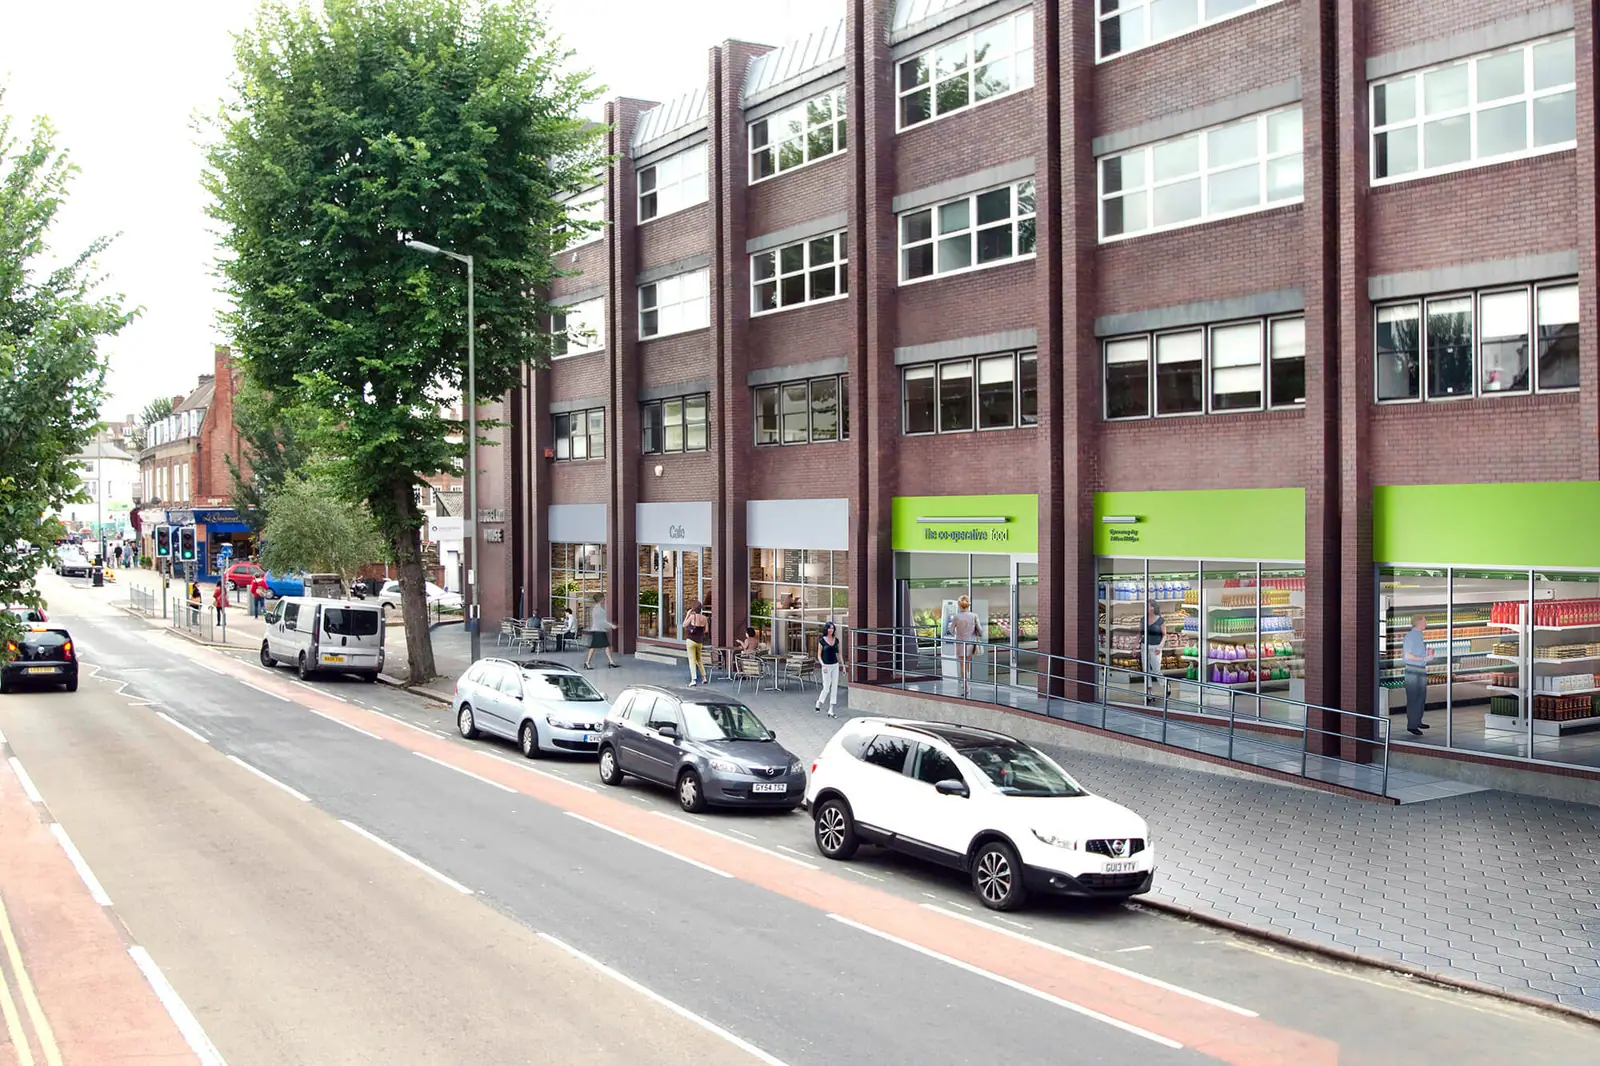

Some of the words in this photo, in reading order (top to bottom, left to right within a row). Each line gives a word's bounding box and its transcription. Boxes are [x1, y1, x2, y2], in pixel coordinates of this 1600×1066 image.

[924, 528, 937, 540] The
[938, 528, 988, 543] co-operative
[991, 528, 1009, 541] food
[1105, 862, 1122, 872] GU13
[1123, 862, 1136, 871] YTV
